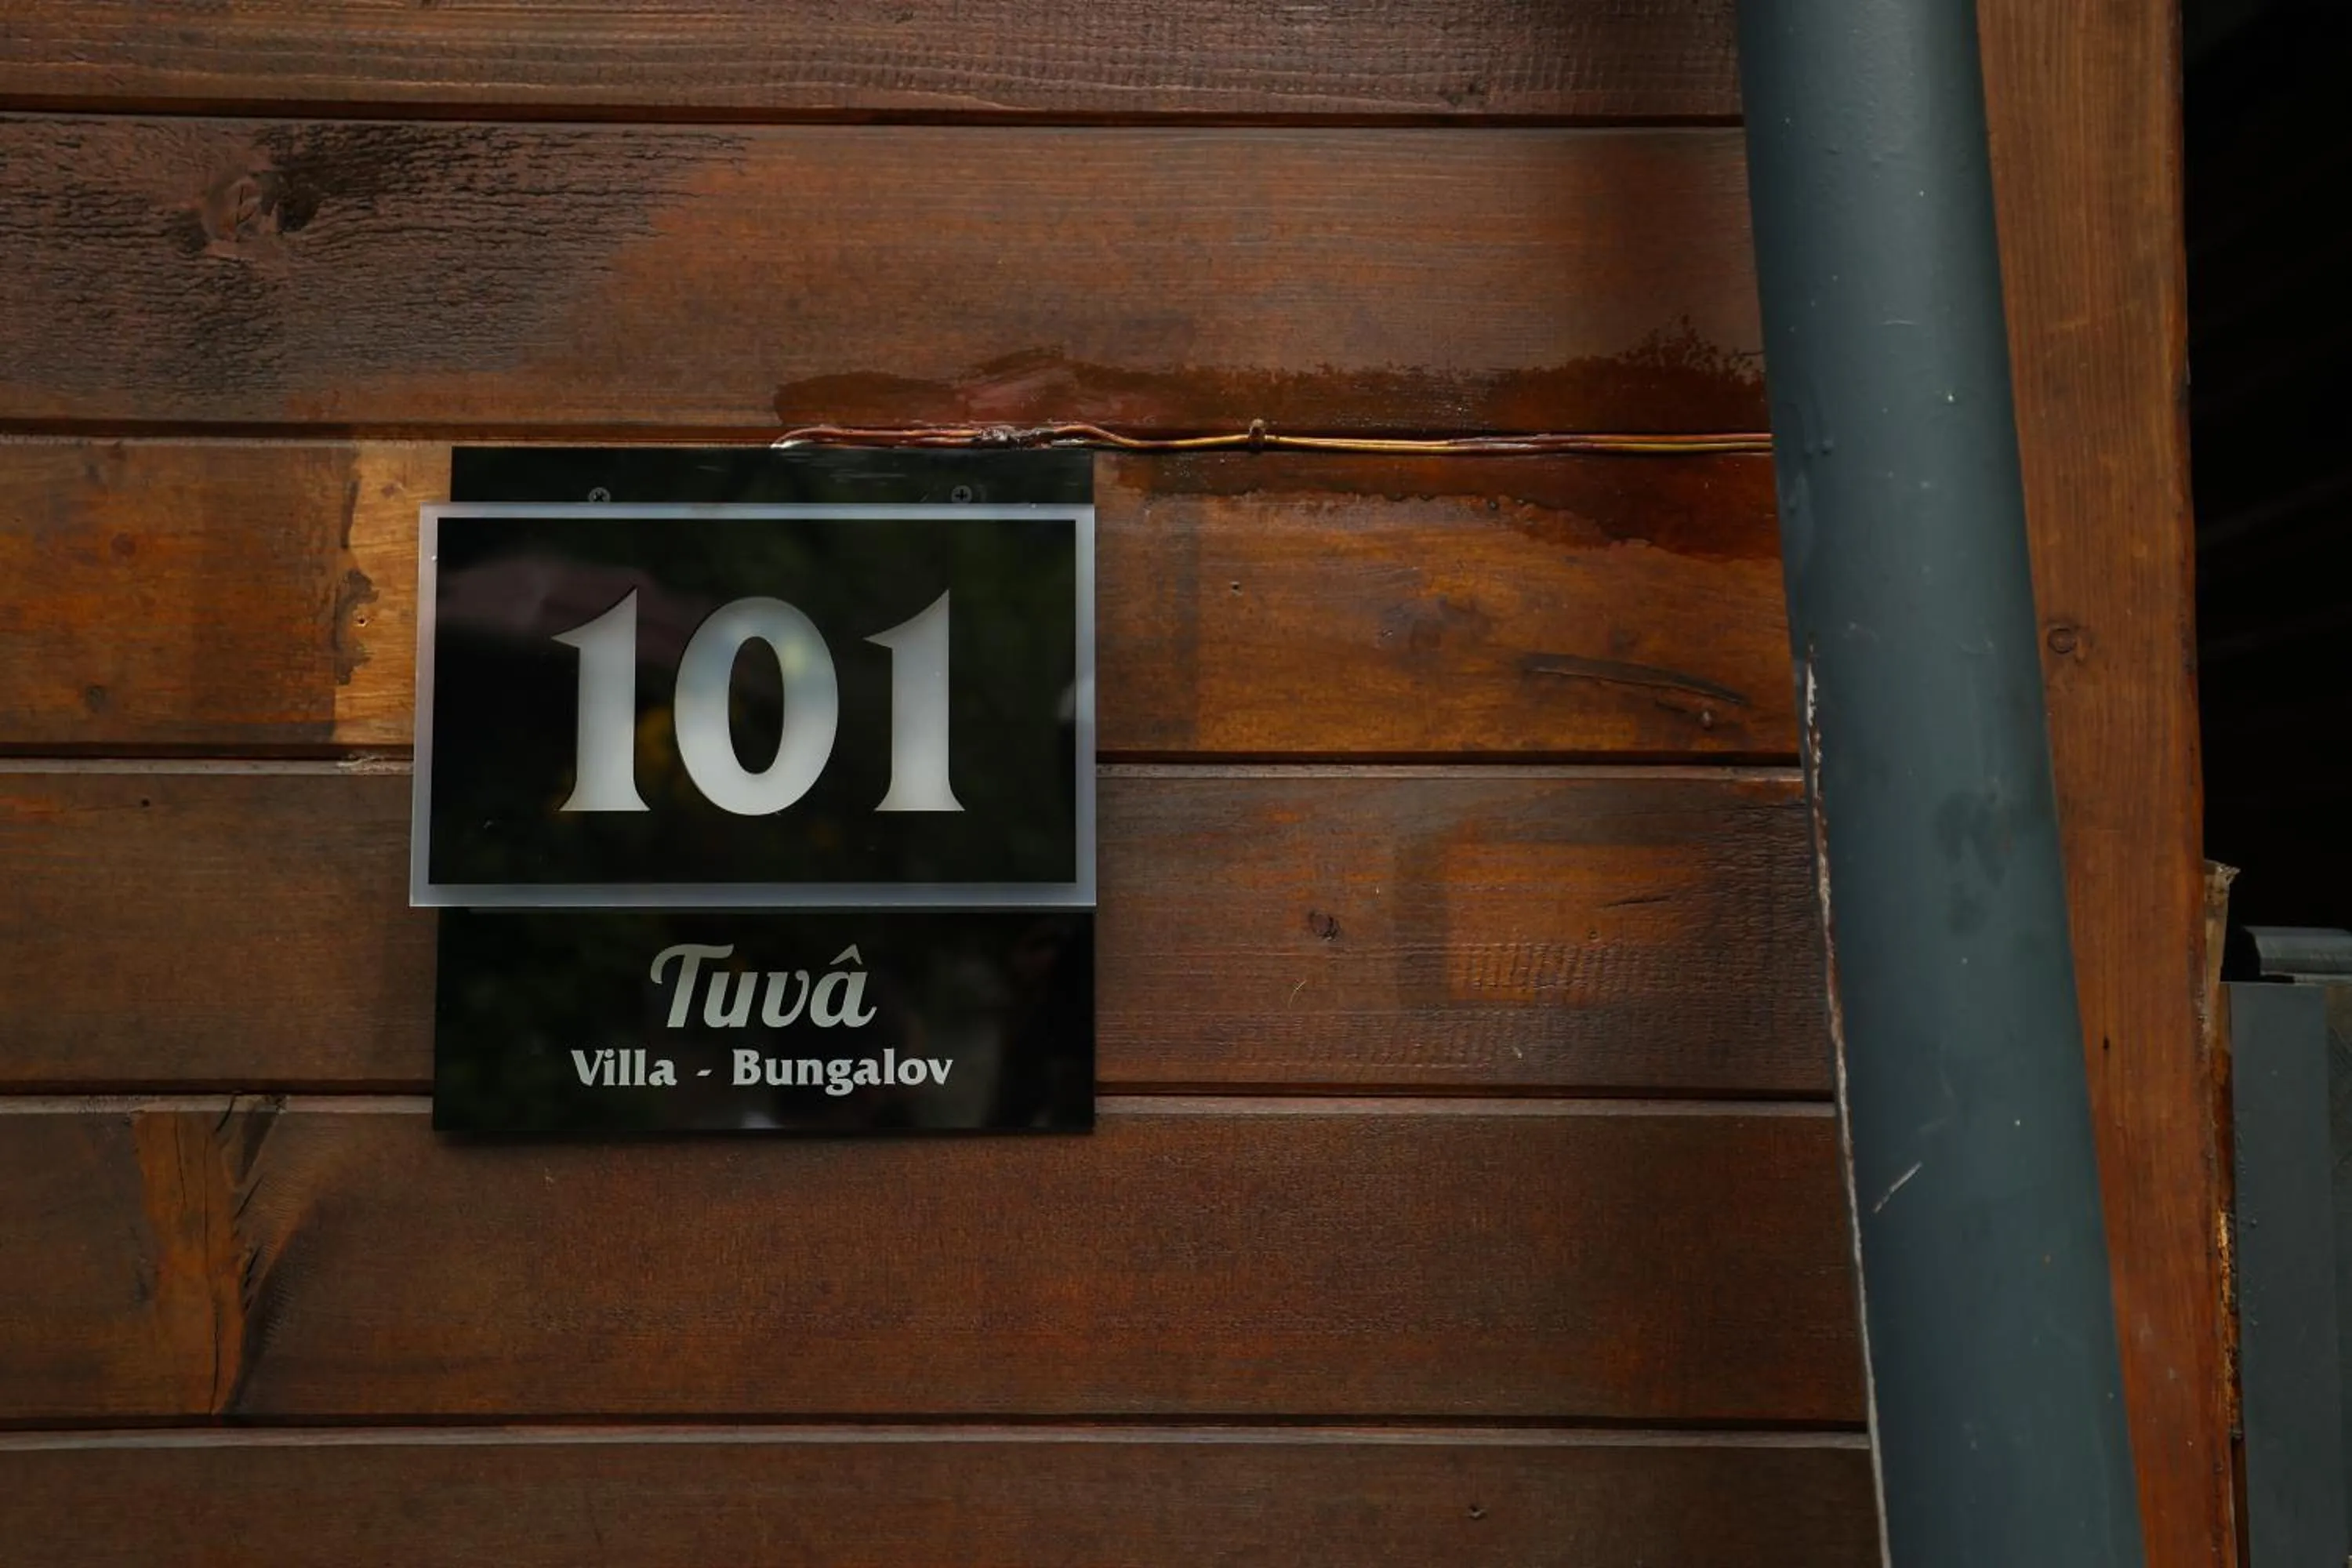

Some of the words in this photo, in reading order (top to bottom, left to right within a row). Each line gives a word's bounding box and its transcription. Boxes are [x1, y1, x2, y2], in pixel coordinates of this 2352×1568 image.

[550, 588, 966, 817] 101
[649, 942, 877, 1029] Tuvâ
[571, 1048, 677, 1087] Villa
[732, 1048, 953, 1097] Bungalov
